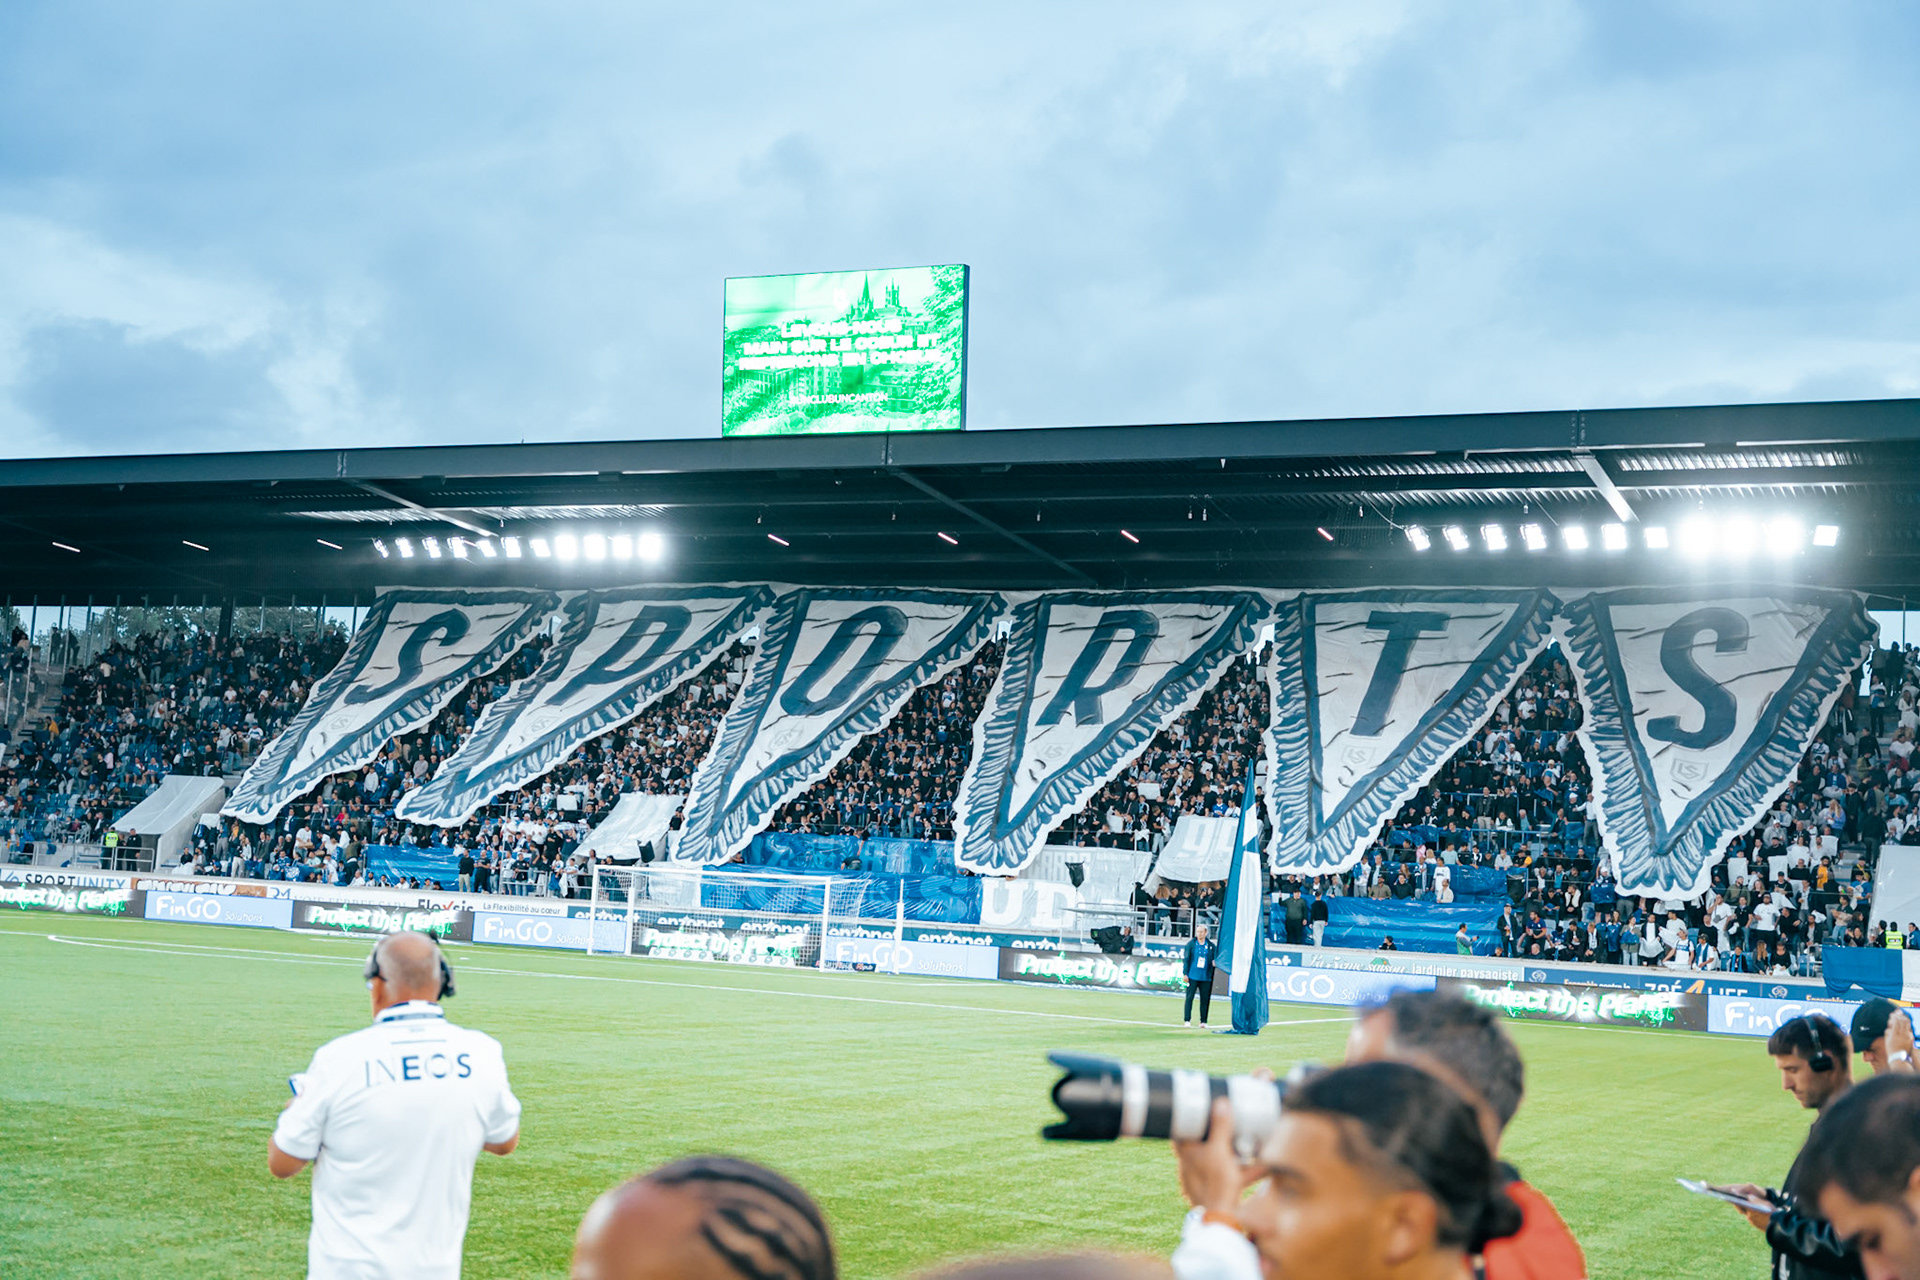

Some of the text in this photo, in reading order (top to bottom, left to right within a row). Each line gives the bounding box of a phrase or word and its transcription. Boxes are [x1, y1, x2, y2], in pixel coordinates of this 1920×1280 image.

[156, 895, 221, 919] FinGO
[484, 917, 552, 942] FinGO
[365, 1053, 472, 1088] INEOS
